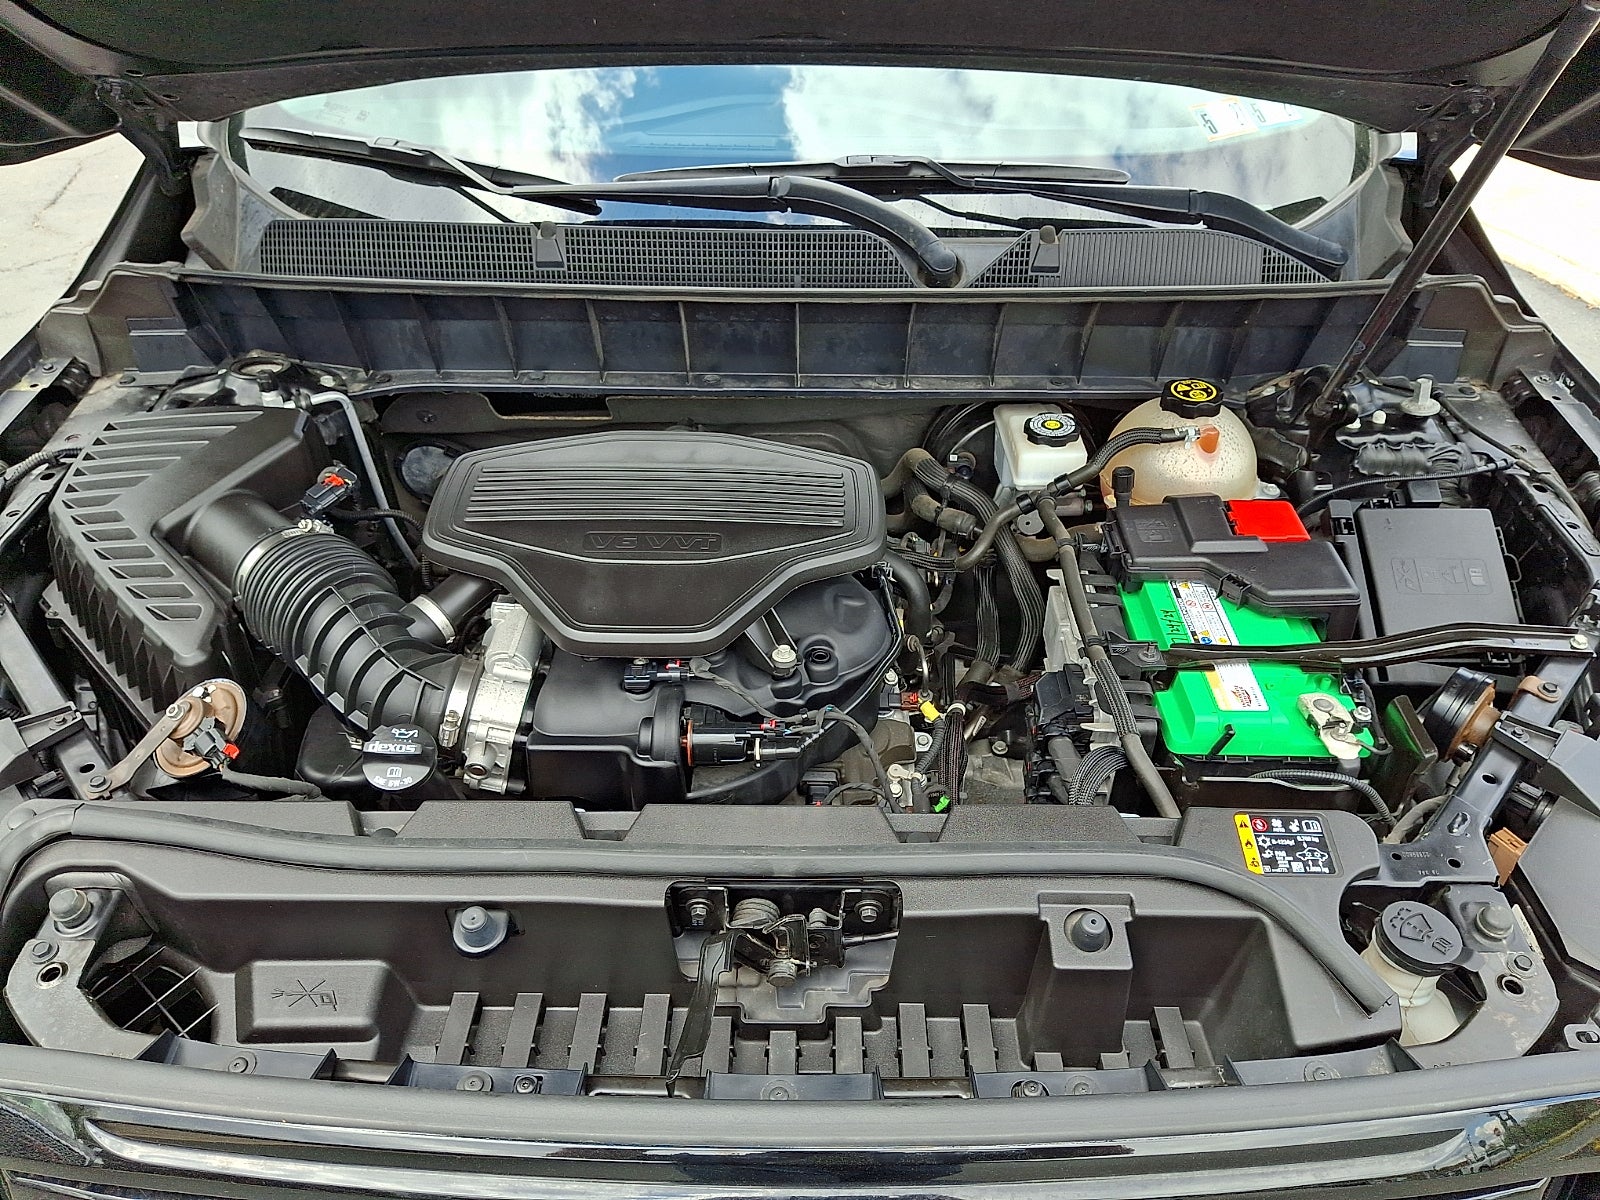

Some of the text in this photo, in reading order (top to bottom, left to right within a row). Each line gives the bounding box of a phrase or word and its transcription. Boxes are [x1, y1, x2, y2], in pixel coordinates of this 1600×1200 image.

[1200, 113, 1218, 135] 5
[591, 535, 717, 550] V6 VVT
[368, 740, 416, 753] dexos
